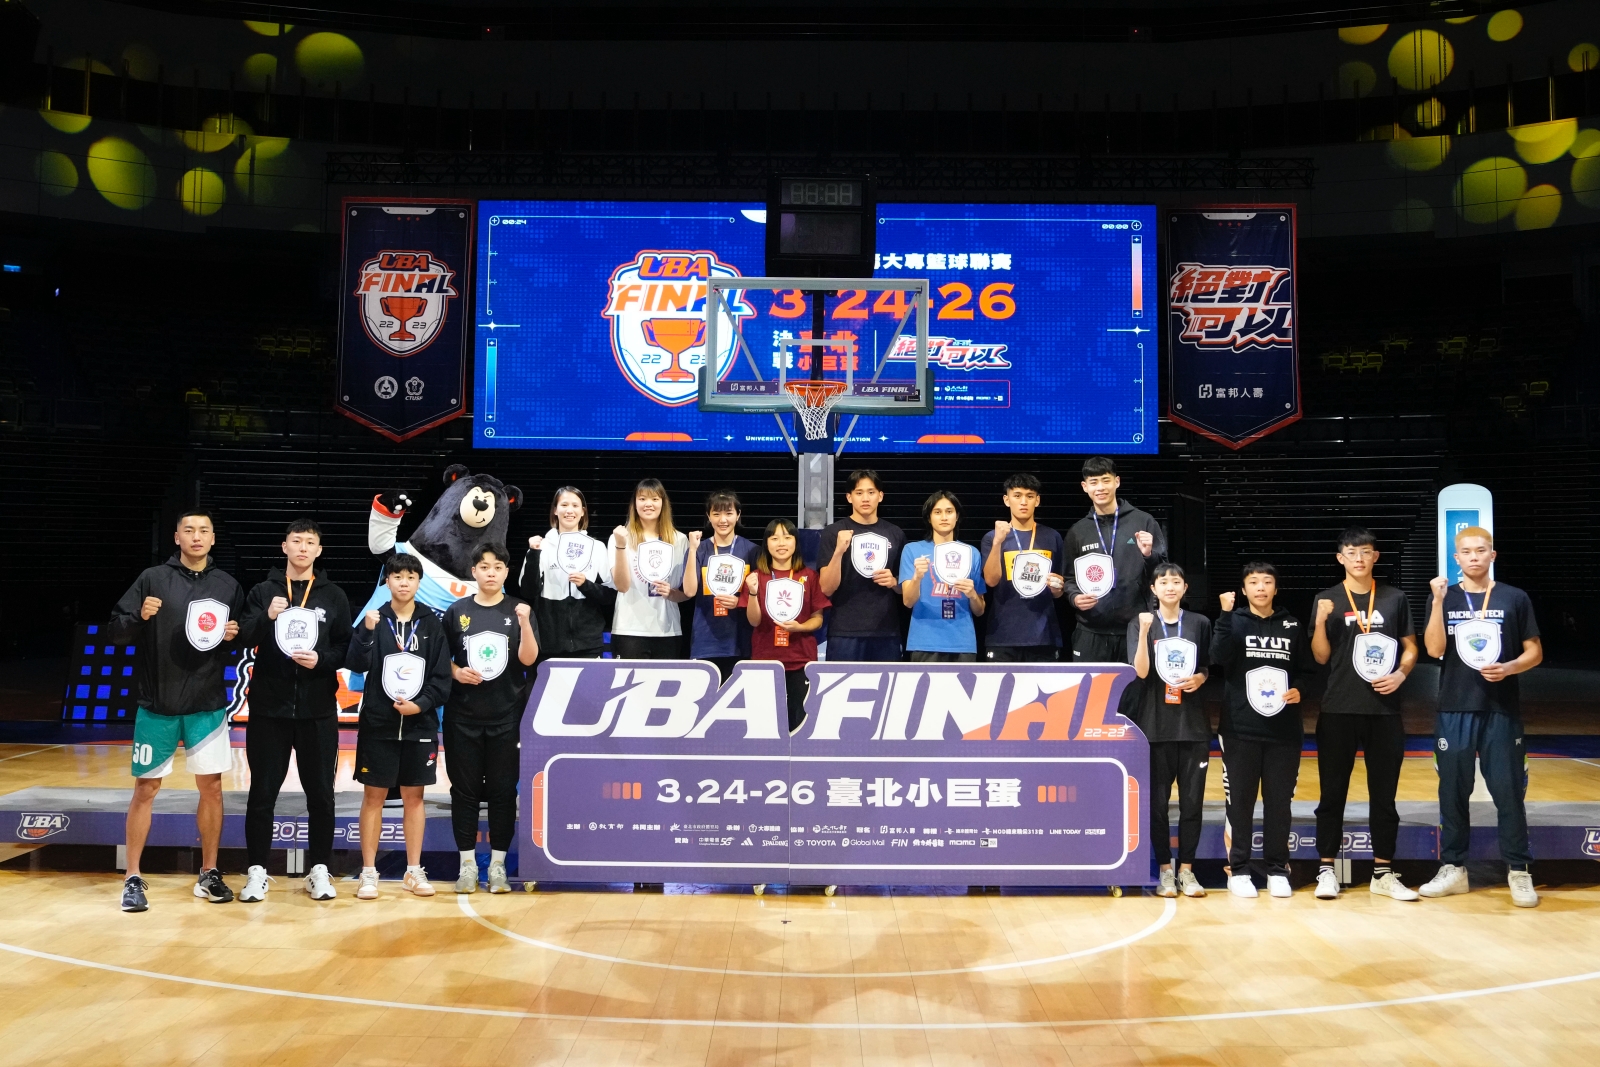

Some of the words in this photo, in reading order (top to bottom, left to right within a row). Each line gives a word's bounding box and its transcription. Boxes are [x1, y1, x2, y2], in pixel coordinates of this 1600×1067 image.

[380, 254, 428, 270] UBA
[639, 257, 711, 277] UBA
[361, 272, 452, 294] FINAL
[769, 282, 1016, 321] 324-26
[379, 320, 394, 329] 22
[412, 321, 427, 330] 23
[641, 354, 662, 364] 22
[1215, 387, 1264, 399] 富邦人壽
[714, 574, 736, 584] SHU
[1020, 572, 1042, 583] SHU
[1485, 610, 1504, 618] TECH
[1245, 635, 1291, 650] CYUT
[1246, 652, 1291, 661] BASKETBALL
[533, 667, 781, 739] UBA
[808, 671, 1128, 740] FINAL
[1083, 728, 1126, 738] 22-23
[133, 744, 152, 766] 50
[657, 779, 816, 804] 3.24-26
[826, 777, 1022, 808] 臺北小巨蛋
[22, 815, 62, 828] UBA
[762, 839, 789, 847] SPALDING
[806, 839, 837, 847] TOYOTA
[891, 839, 909, 847] FIN
